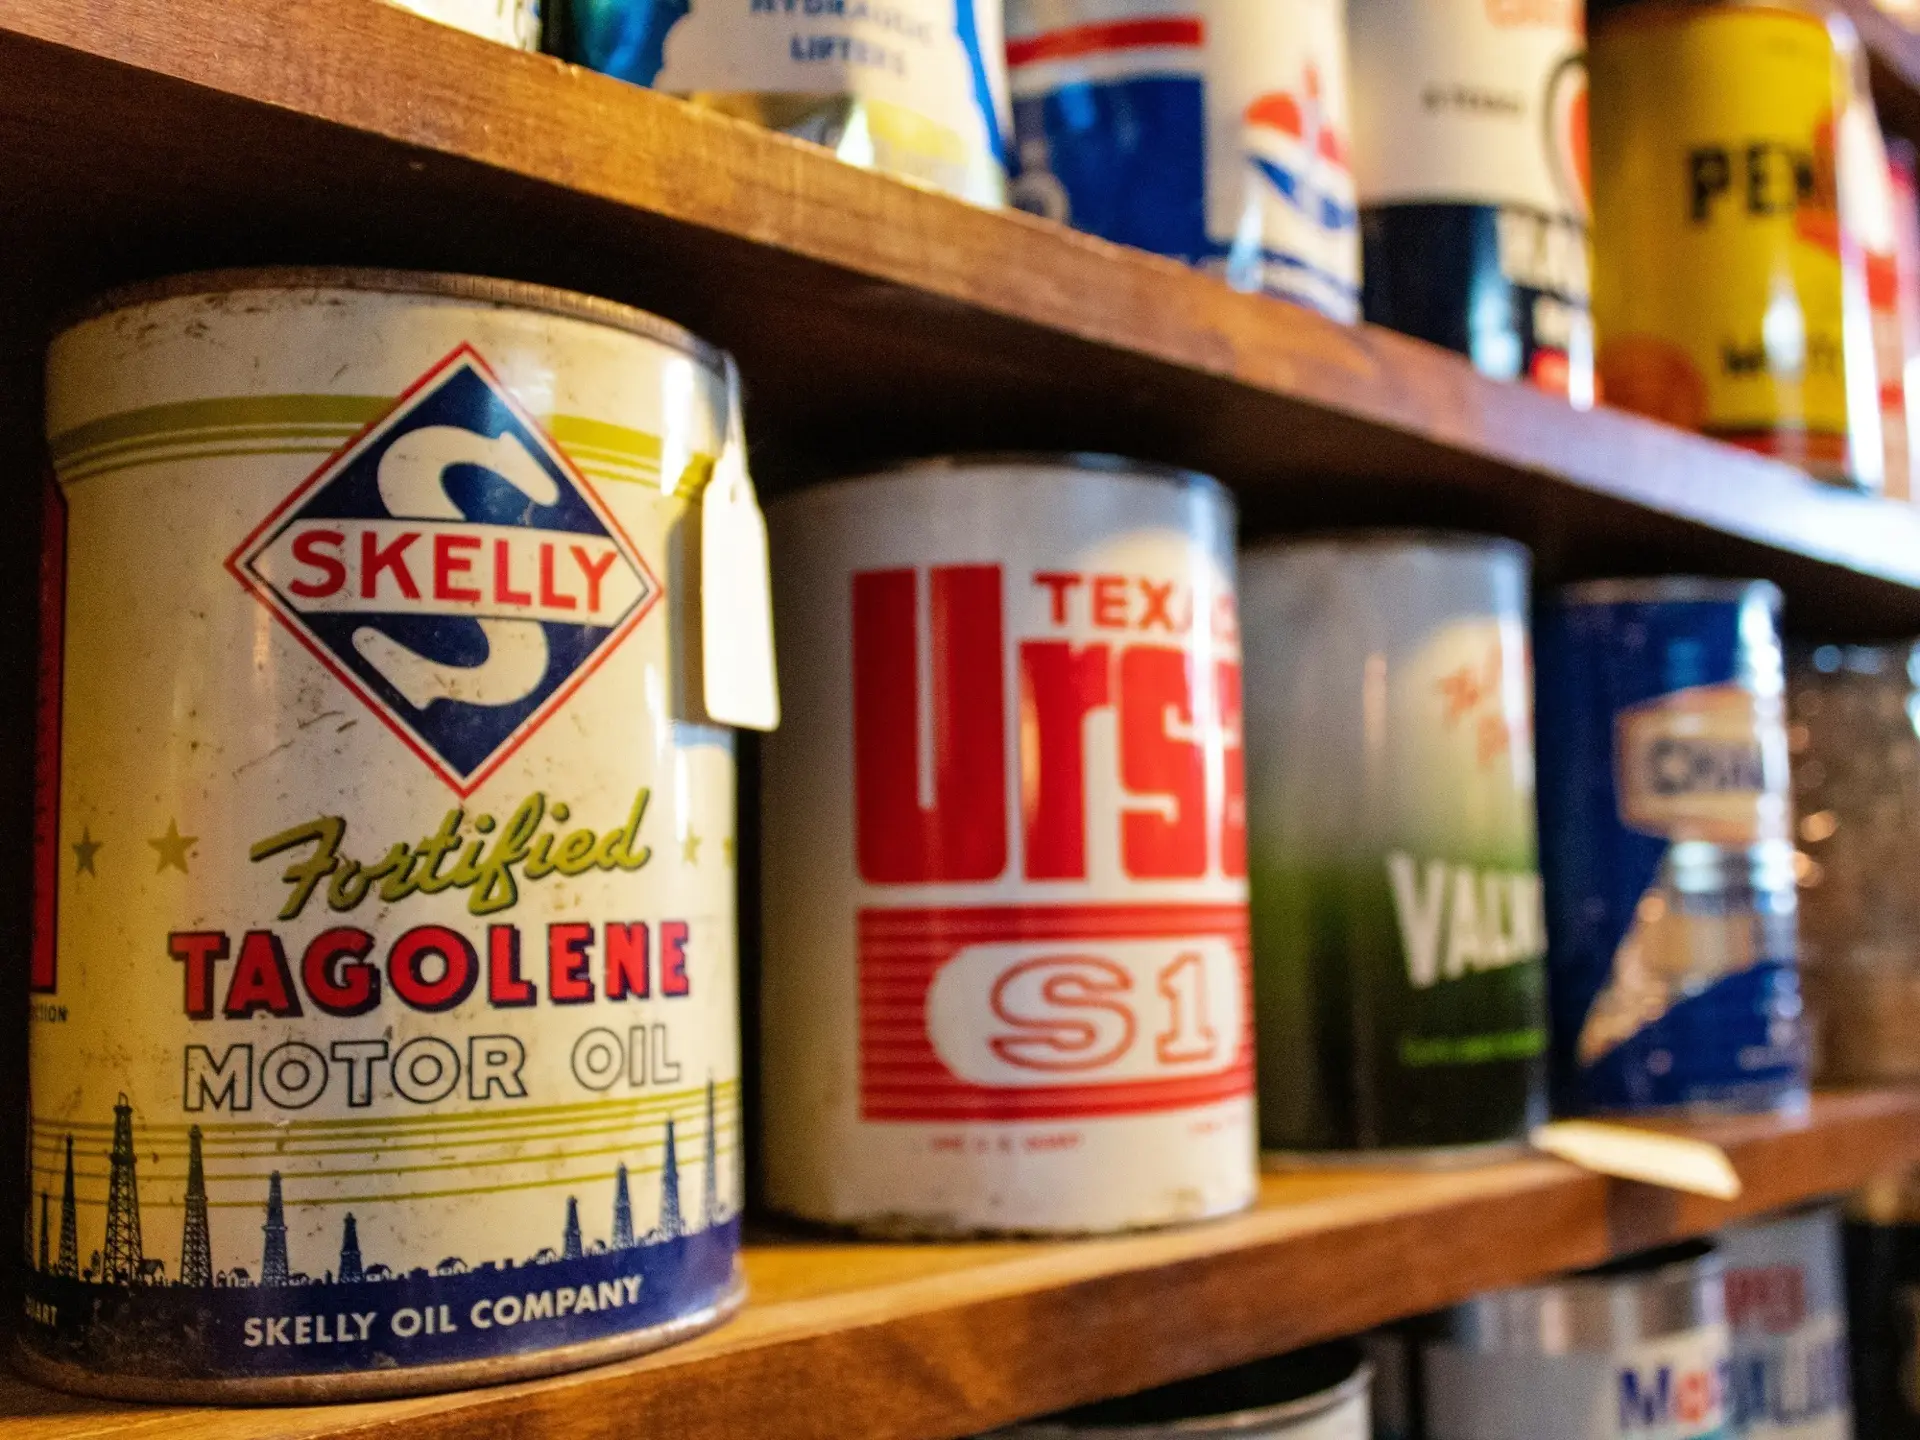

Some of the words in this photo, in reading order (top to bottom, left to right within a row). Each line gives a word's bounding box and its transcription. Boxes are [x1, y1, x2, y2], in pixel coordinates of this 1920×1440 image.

[289, 529, 618, 613] SKELLY
[249, 787, 652, 921] Fortified
[168, 921, 689, 1020] TAGOLENE
[988, 953, 1215, 1072] S1
[184, 1034, 528, 1112] MOTOR
[571, 1024, 682, 1091] OIL
[243, 1311, 377, 1347] SKELLY
[391, 1304, 457, 1338] OIL
[470, 1274, 643, 1329] COMPANY
